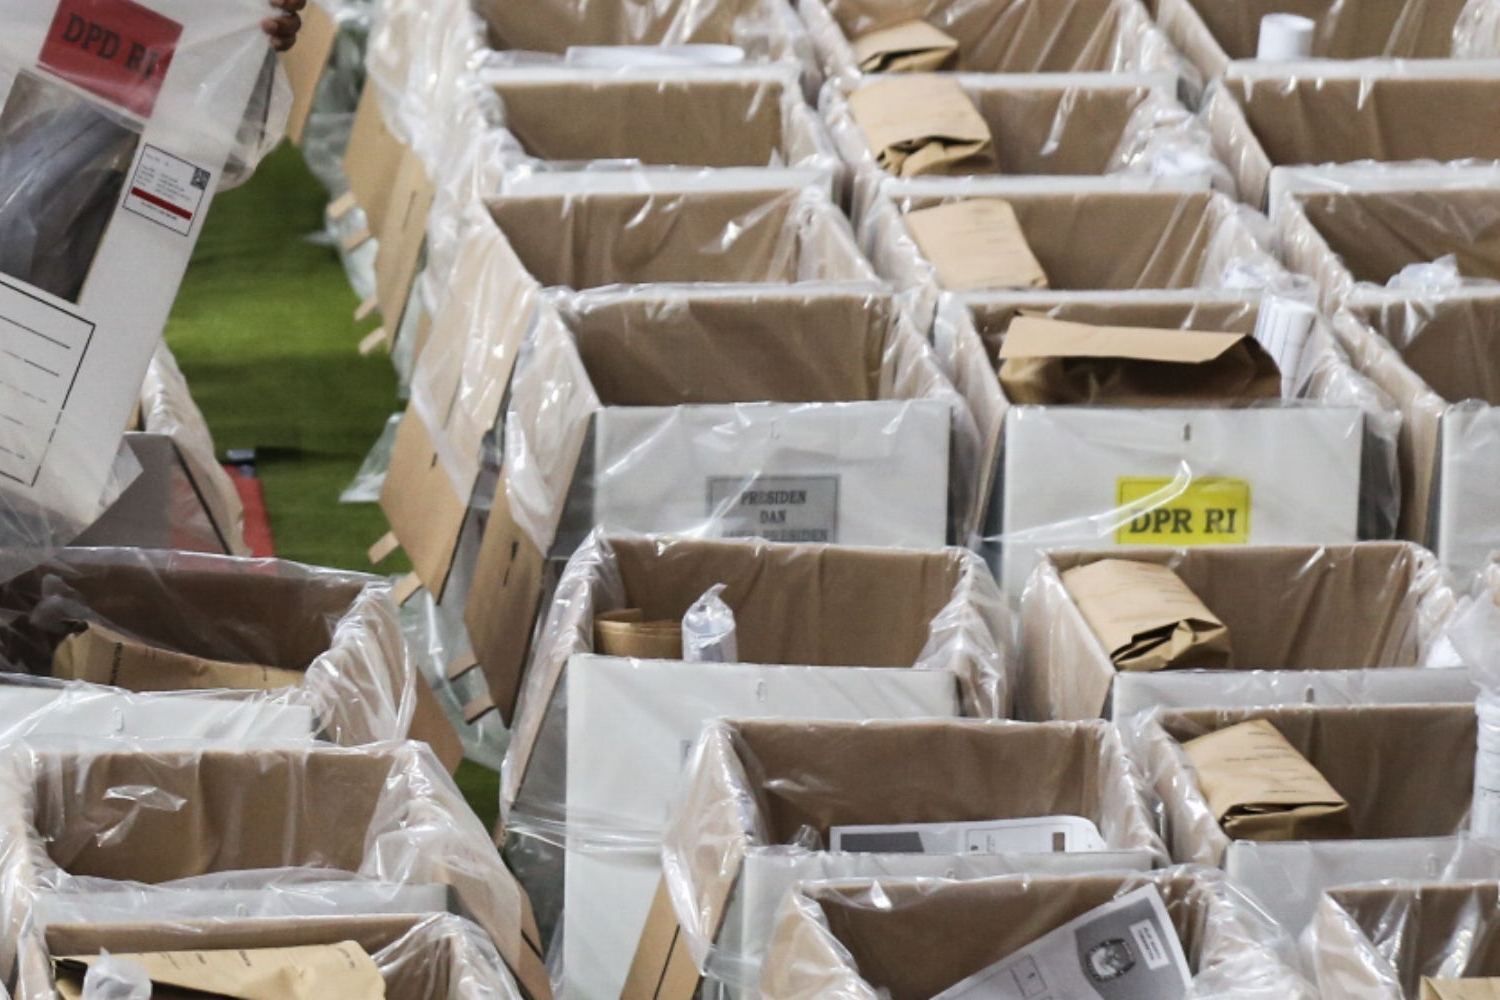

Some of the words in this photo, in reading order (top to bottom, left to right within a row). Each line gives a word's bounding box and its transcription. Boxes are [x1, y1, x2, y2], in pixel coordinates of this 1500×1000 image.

[62, 13, 121, 60] DPD
[124, 41, 159, 79] RI
[740, 489, 807, 505] PRESIDEN
[759, 509, 787, 525] DAN
[1128, 507, 1194, 534] DPR
[1203, 507, 1237, 534] RI
